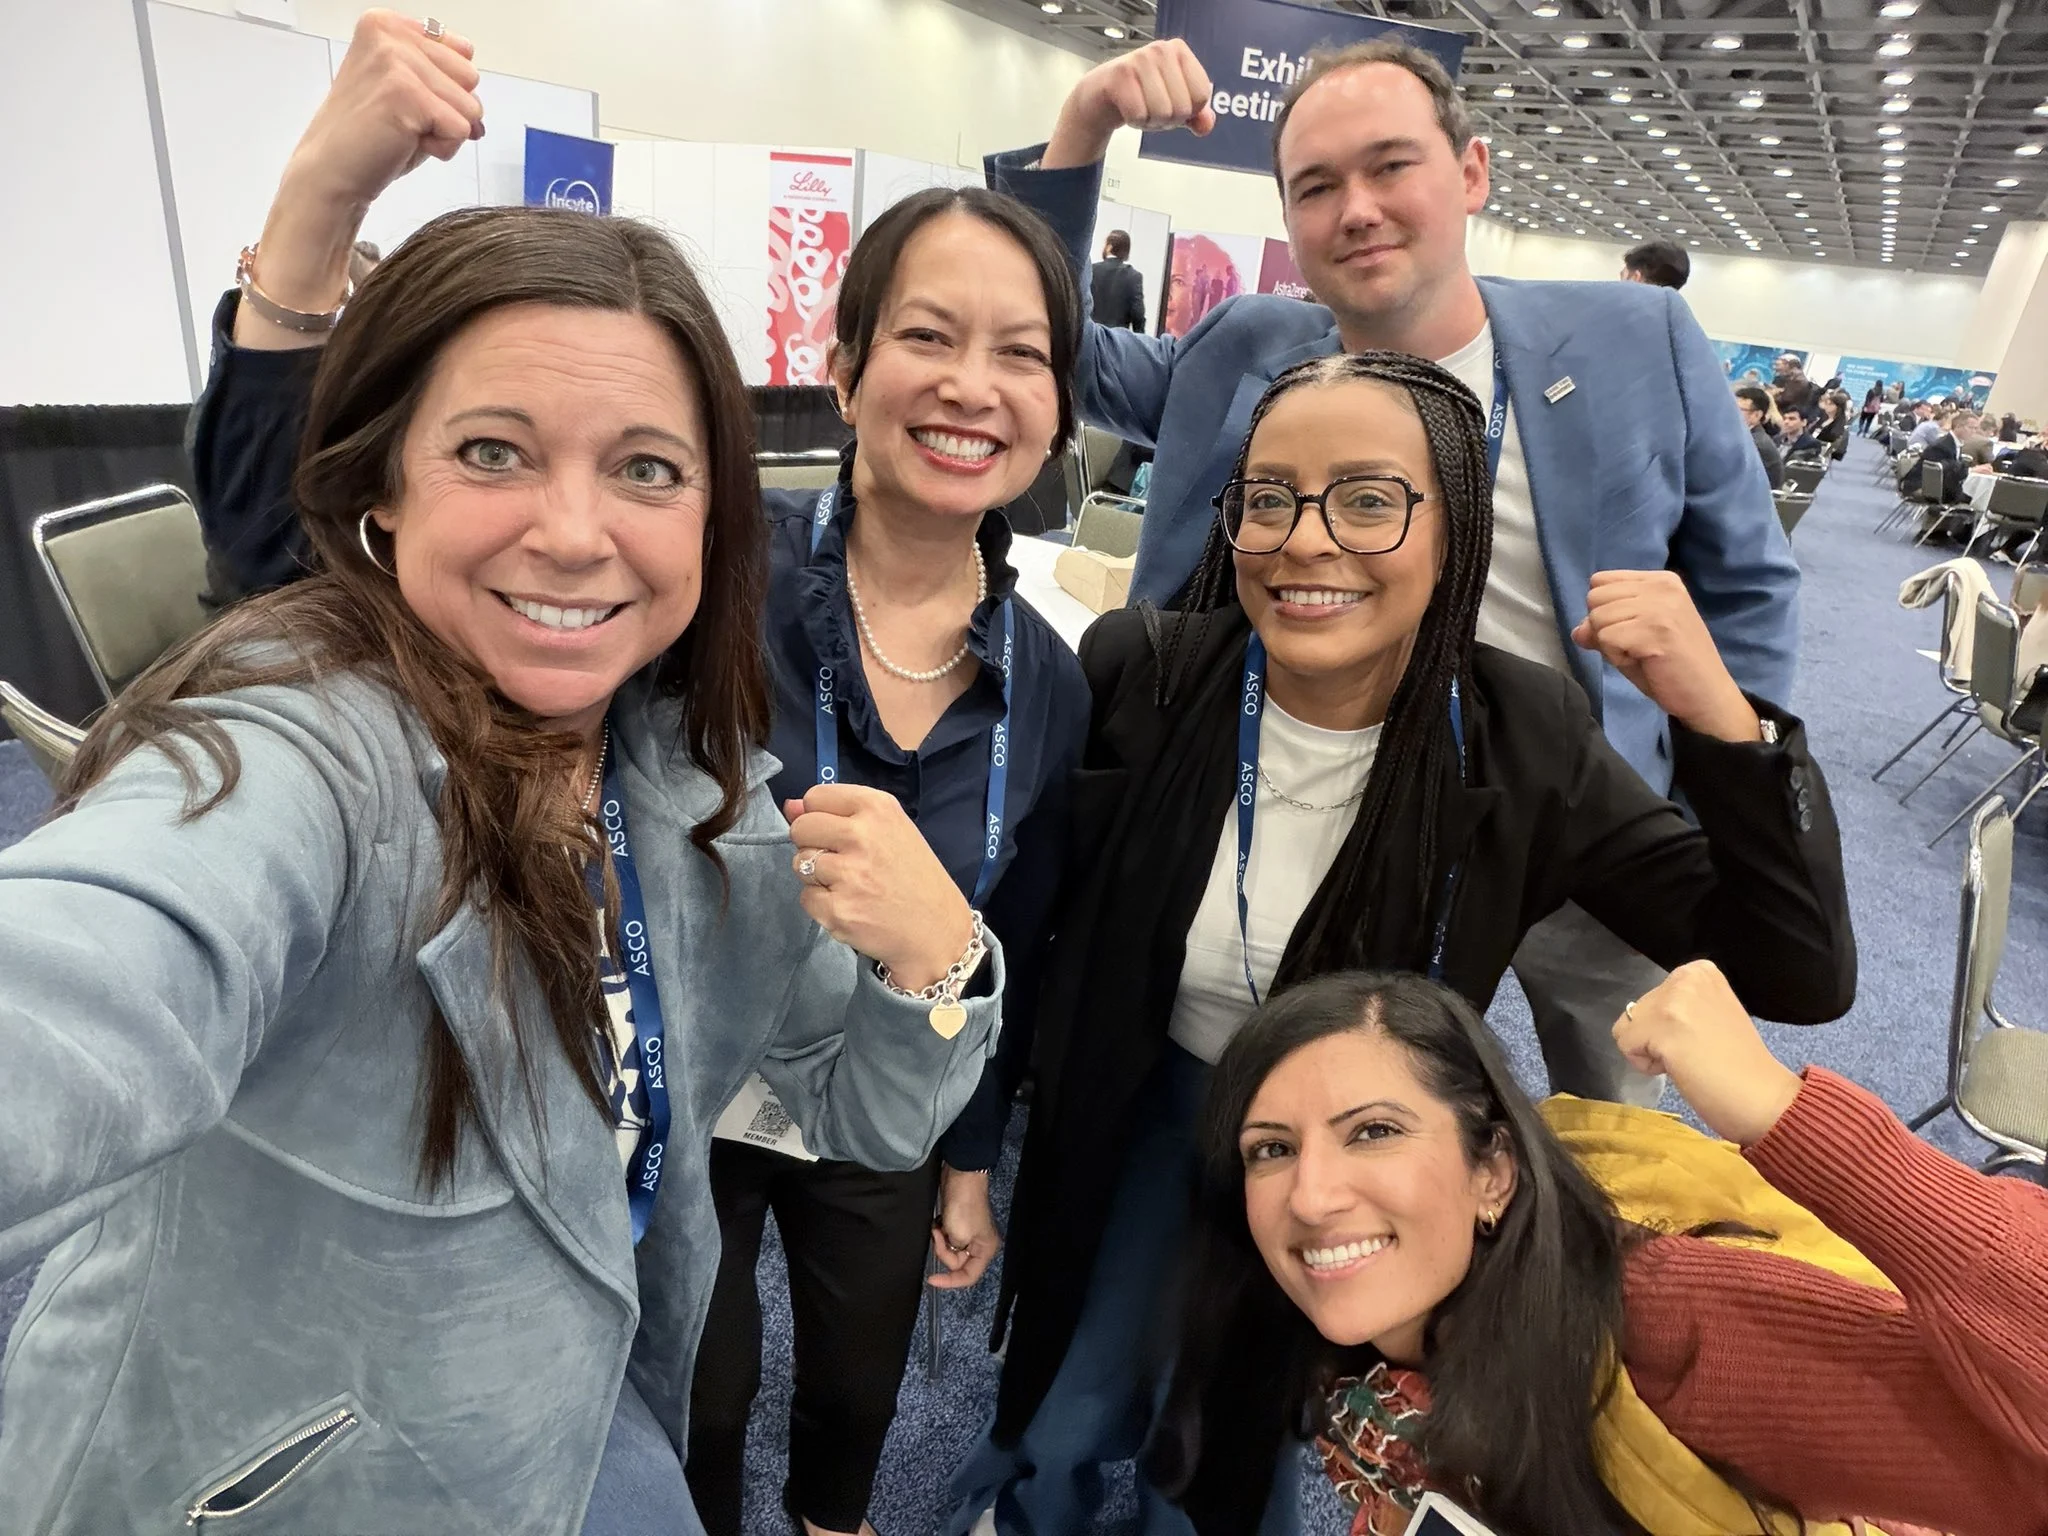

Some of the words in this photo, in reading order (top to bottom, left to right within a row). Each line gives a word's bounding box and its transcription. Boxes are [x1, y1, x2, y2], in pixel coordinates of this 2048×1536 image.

[1240, 46, 1314, 86] Exhi
[789, 171, 832, 197] Lilly
[1490, 403, 1504, 439] ASCO
[817, 492, 832, 527] ASCO
[1003, 633, 1012, 679] ASCO
[820, 666, 834, 715] ASCO
[1244, 671, 1259, 717] ASCO
[993, 722, 1005, 768] ASCO
[1241, 761, 1253, 807] ASCO
[603, 799, 628, 858] ASCO
[986, 812, 1000, 860] ASCO
[1236, 850, 1247, 895] ASCO
[625, 919, 650, 976] ASCO
[645, 1037, 665, 1090] ASCO
[742, 1132, 778, 1147] MEMBER
[641, 1143, 665, 1191] ASCO
